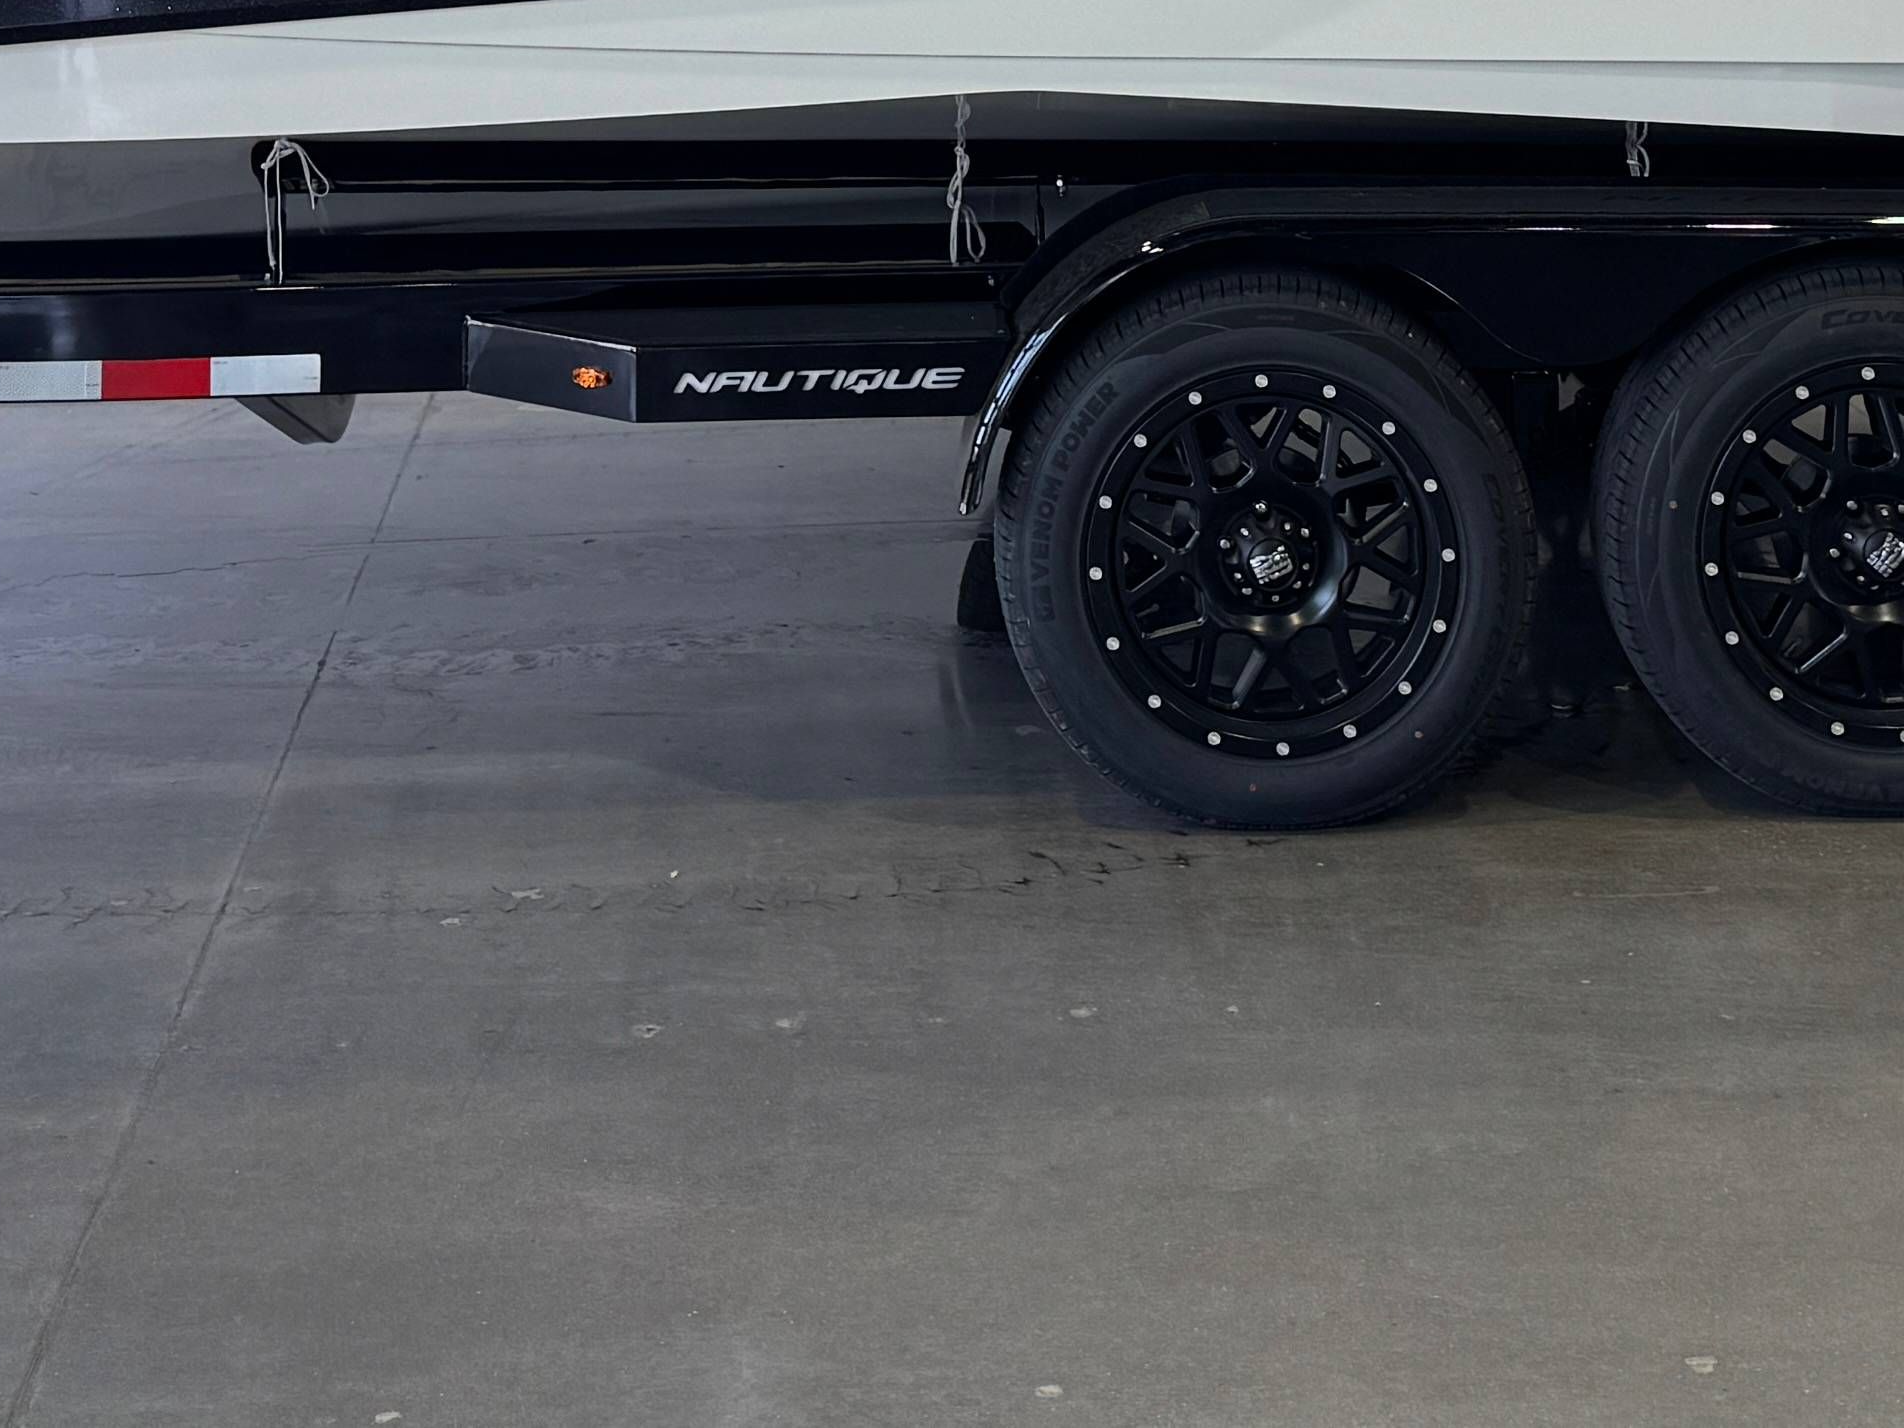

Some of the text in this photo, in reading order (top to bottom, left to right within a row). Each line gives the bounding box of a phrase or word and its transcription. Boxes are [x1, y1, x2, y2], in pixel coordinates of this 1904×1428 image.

[673, 367, 966, 395] NAUTIQUE
[1031, 381, 1121, 581] VENOM POWER
